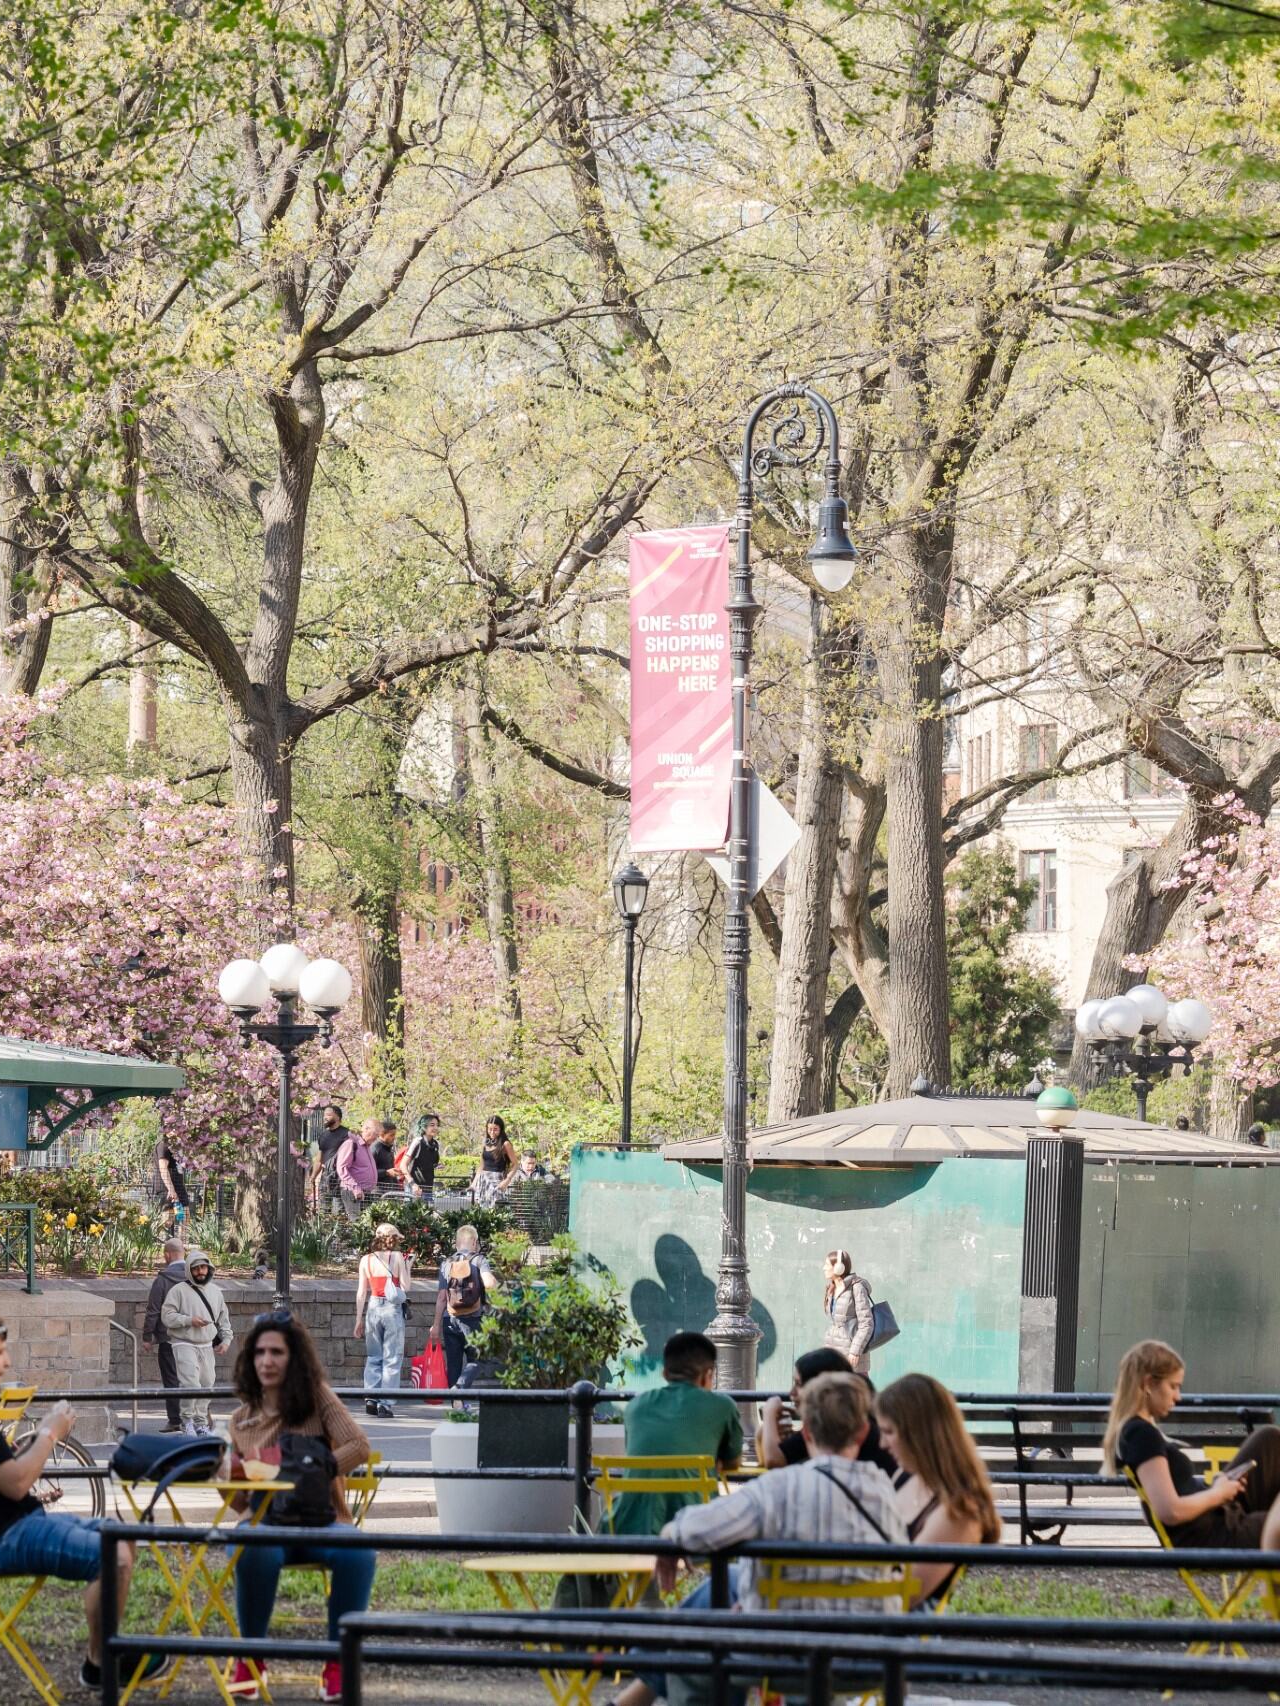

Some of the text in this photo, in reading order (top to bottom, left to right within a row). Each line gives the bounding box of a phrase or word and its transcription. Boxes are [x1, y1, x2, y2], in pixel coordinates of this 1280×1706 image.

[638, 613, 717, 632] ONE-STOP
[645, 634, 725, 652] SHOPPING
[647, 654, 719, 673] HAPPENS
[678, 675, 717, 692] HERE
[657, 752, 693, 765] UNION
